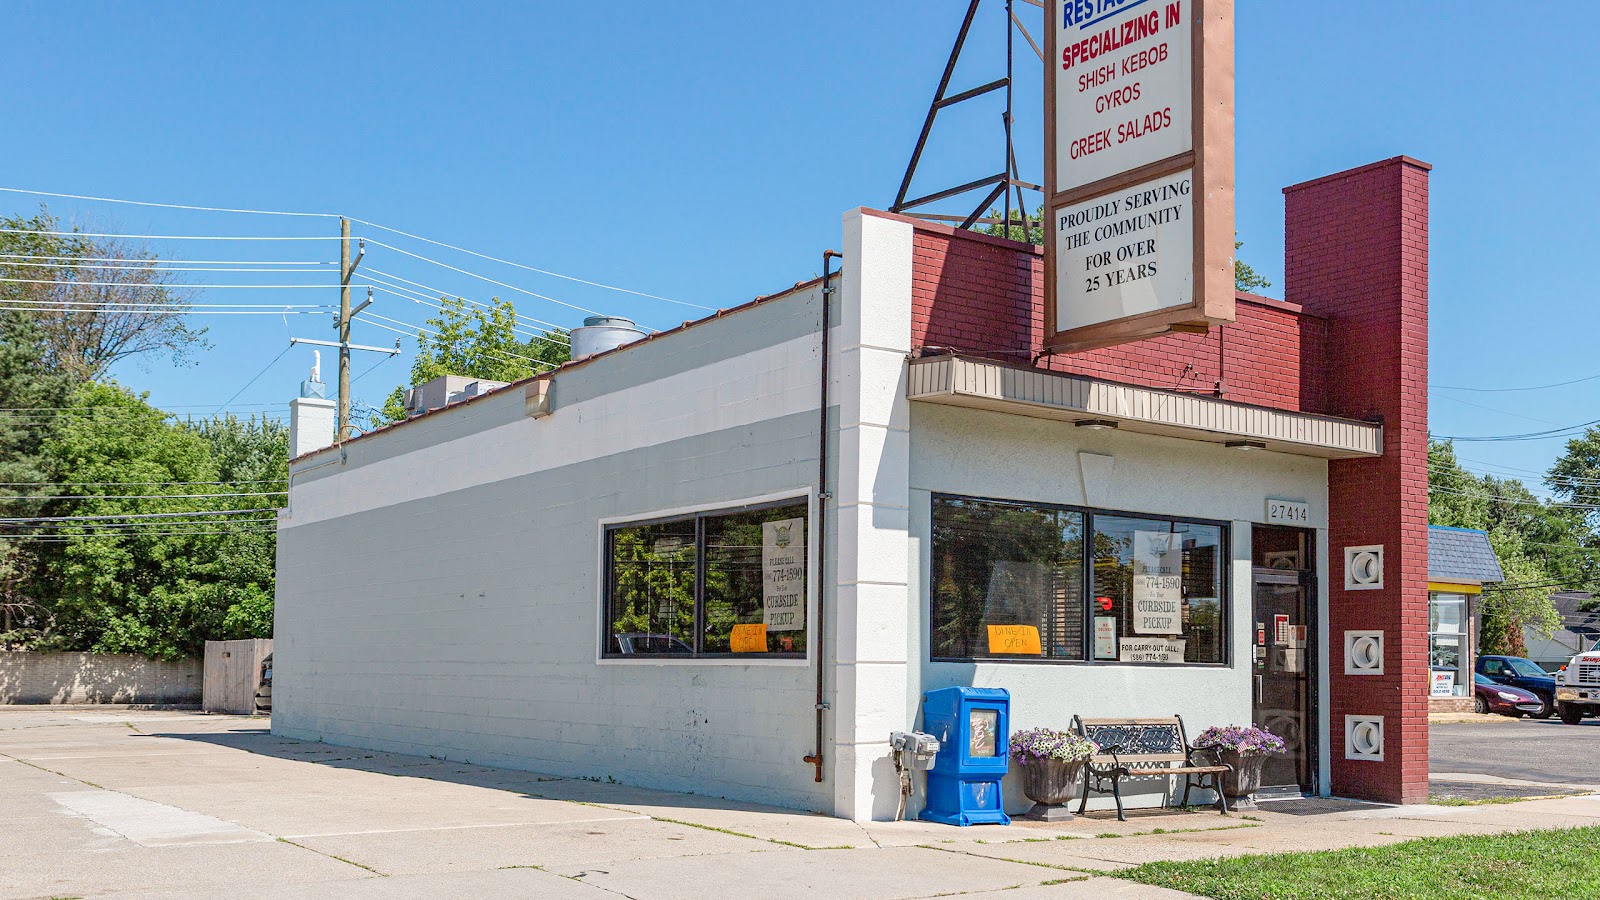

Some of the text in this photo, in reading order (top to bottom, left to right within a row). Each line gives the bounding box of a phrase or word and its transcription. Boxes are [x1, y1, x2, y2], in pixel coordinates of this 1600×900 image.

[1062, 1, 1181, 70] SPECIALIZING IN
[1078, 42, 1168, 92] SHISH KEBOB
[1095, 82, 1141, 113] GYROS
[1070, 107, 1171, 160] GREEK SALADS
[1059, 179, 1190, 231] PROUDLY SERVING
[1065, 204, 1182, 250] THE COMMUNITY
[1085, 238, 1156, 271] FOR OVER
[1085, 261, 1157, 292] 25 YEARS
[1271, 504, 1307, 521] 27414
[773, 567, 802, 582] 774-1590
[1146, 576, 1180, 589] 774-1590
[766, 594, 799, 608] CURBSIDE
[1137, 601, 1176, 613] CURBSIDE
[770, 612, 795, 625] PICKUP
[1143, 617, 1172, 629] PICKUP
[1004, 637, 1028, 648] OPEN
